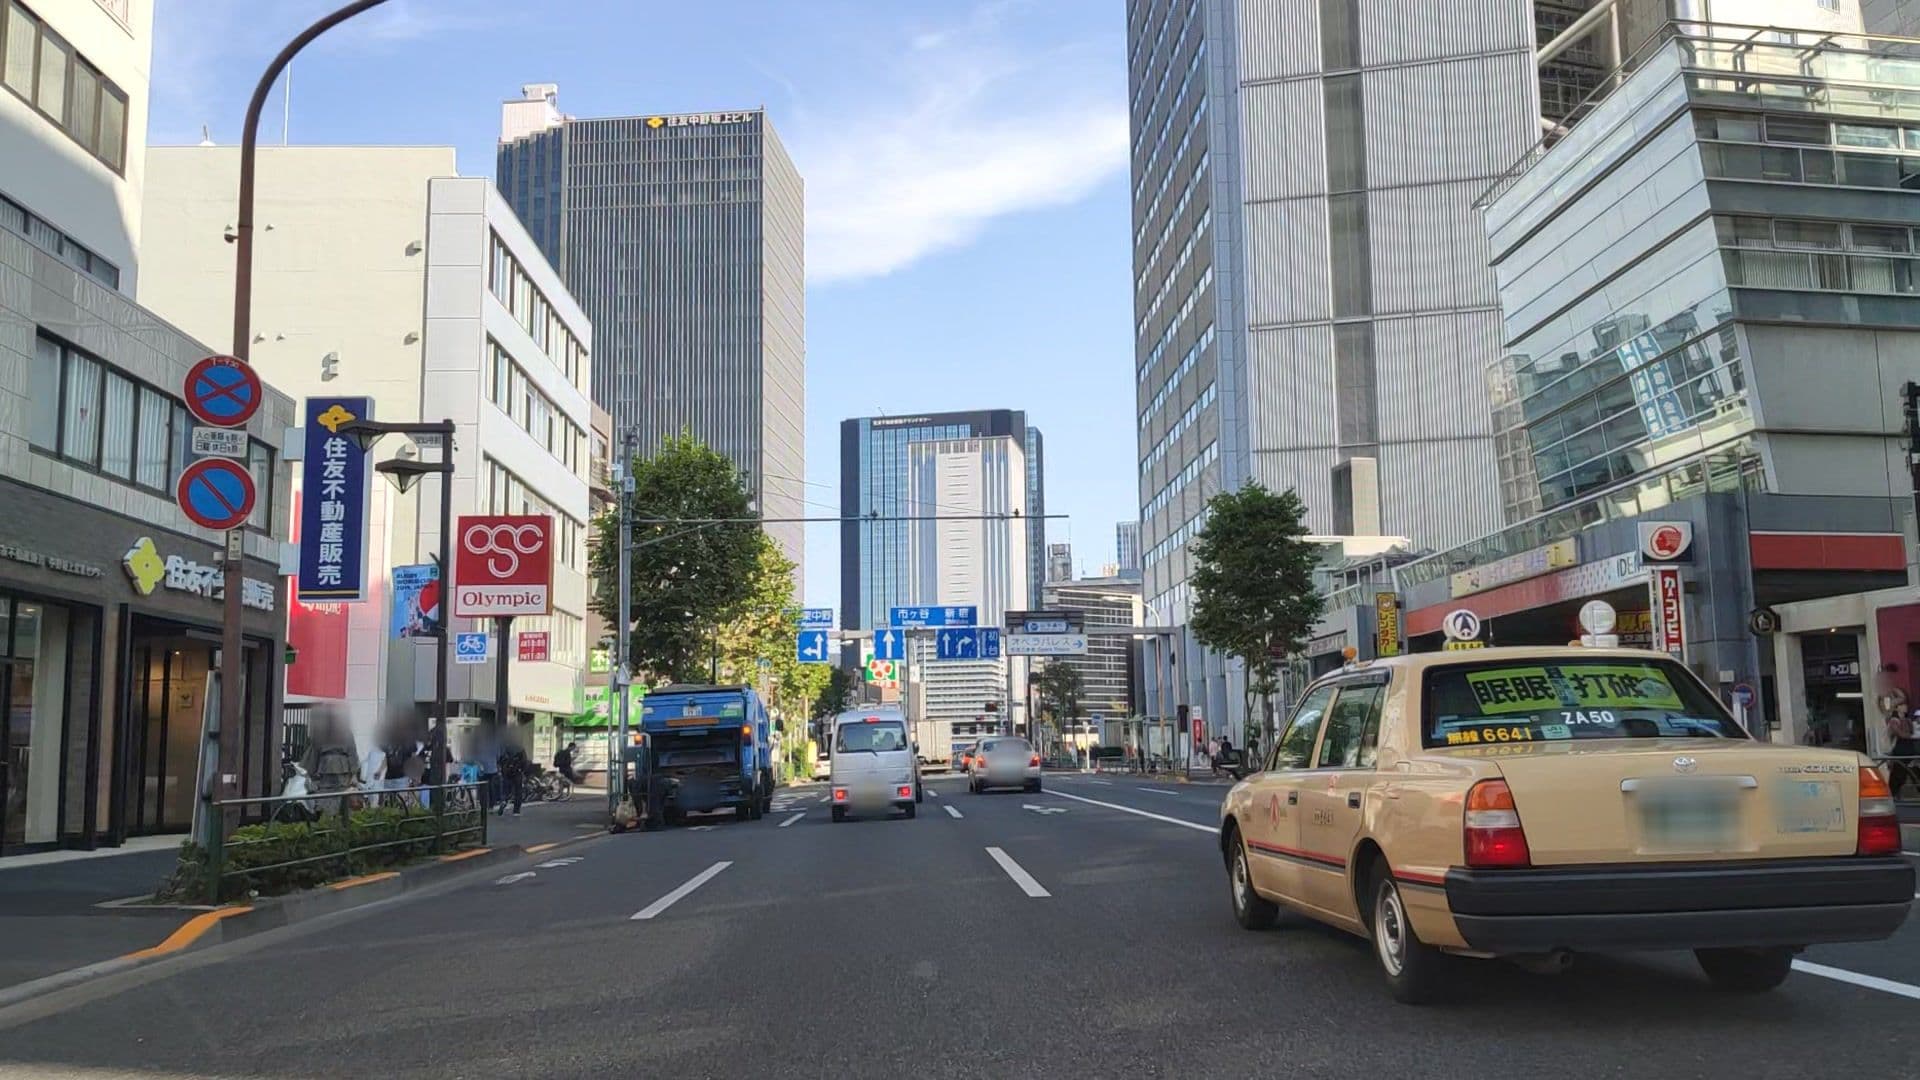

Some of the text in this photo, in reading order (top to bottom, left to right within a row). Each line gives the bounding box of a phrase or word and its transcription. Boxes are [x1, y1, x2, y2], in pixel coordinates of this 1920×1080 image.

[317, 437, 348, 586] 住友不動産販売
[462, 591, 542, 607] Olympic
[898, 608, 969, 619] 市ヶ谷 新宿
[1561, 711, 1615, 725] ZA50
[1482, 727, 1533, 743] 6641
